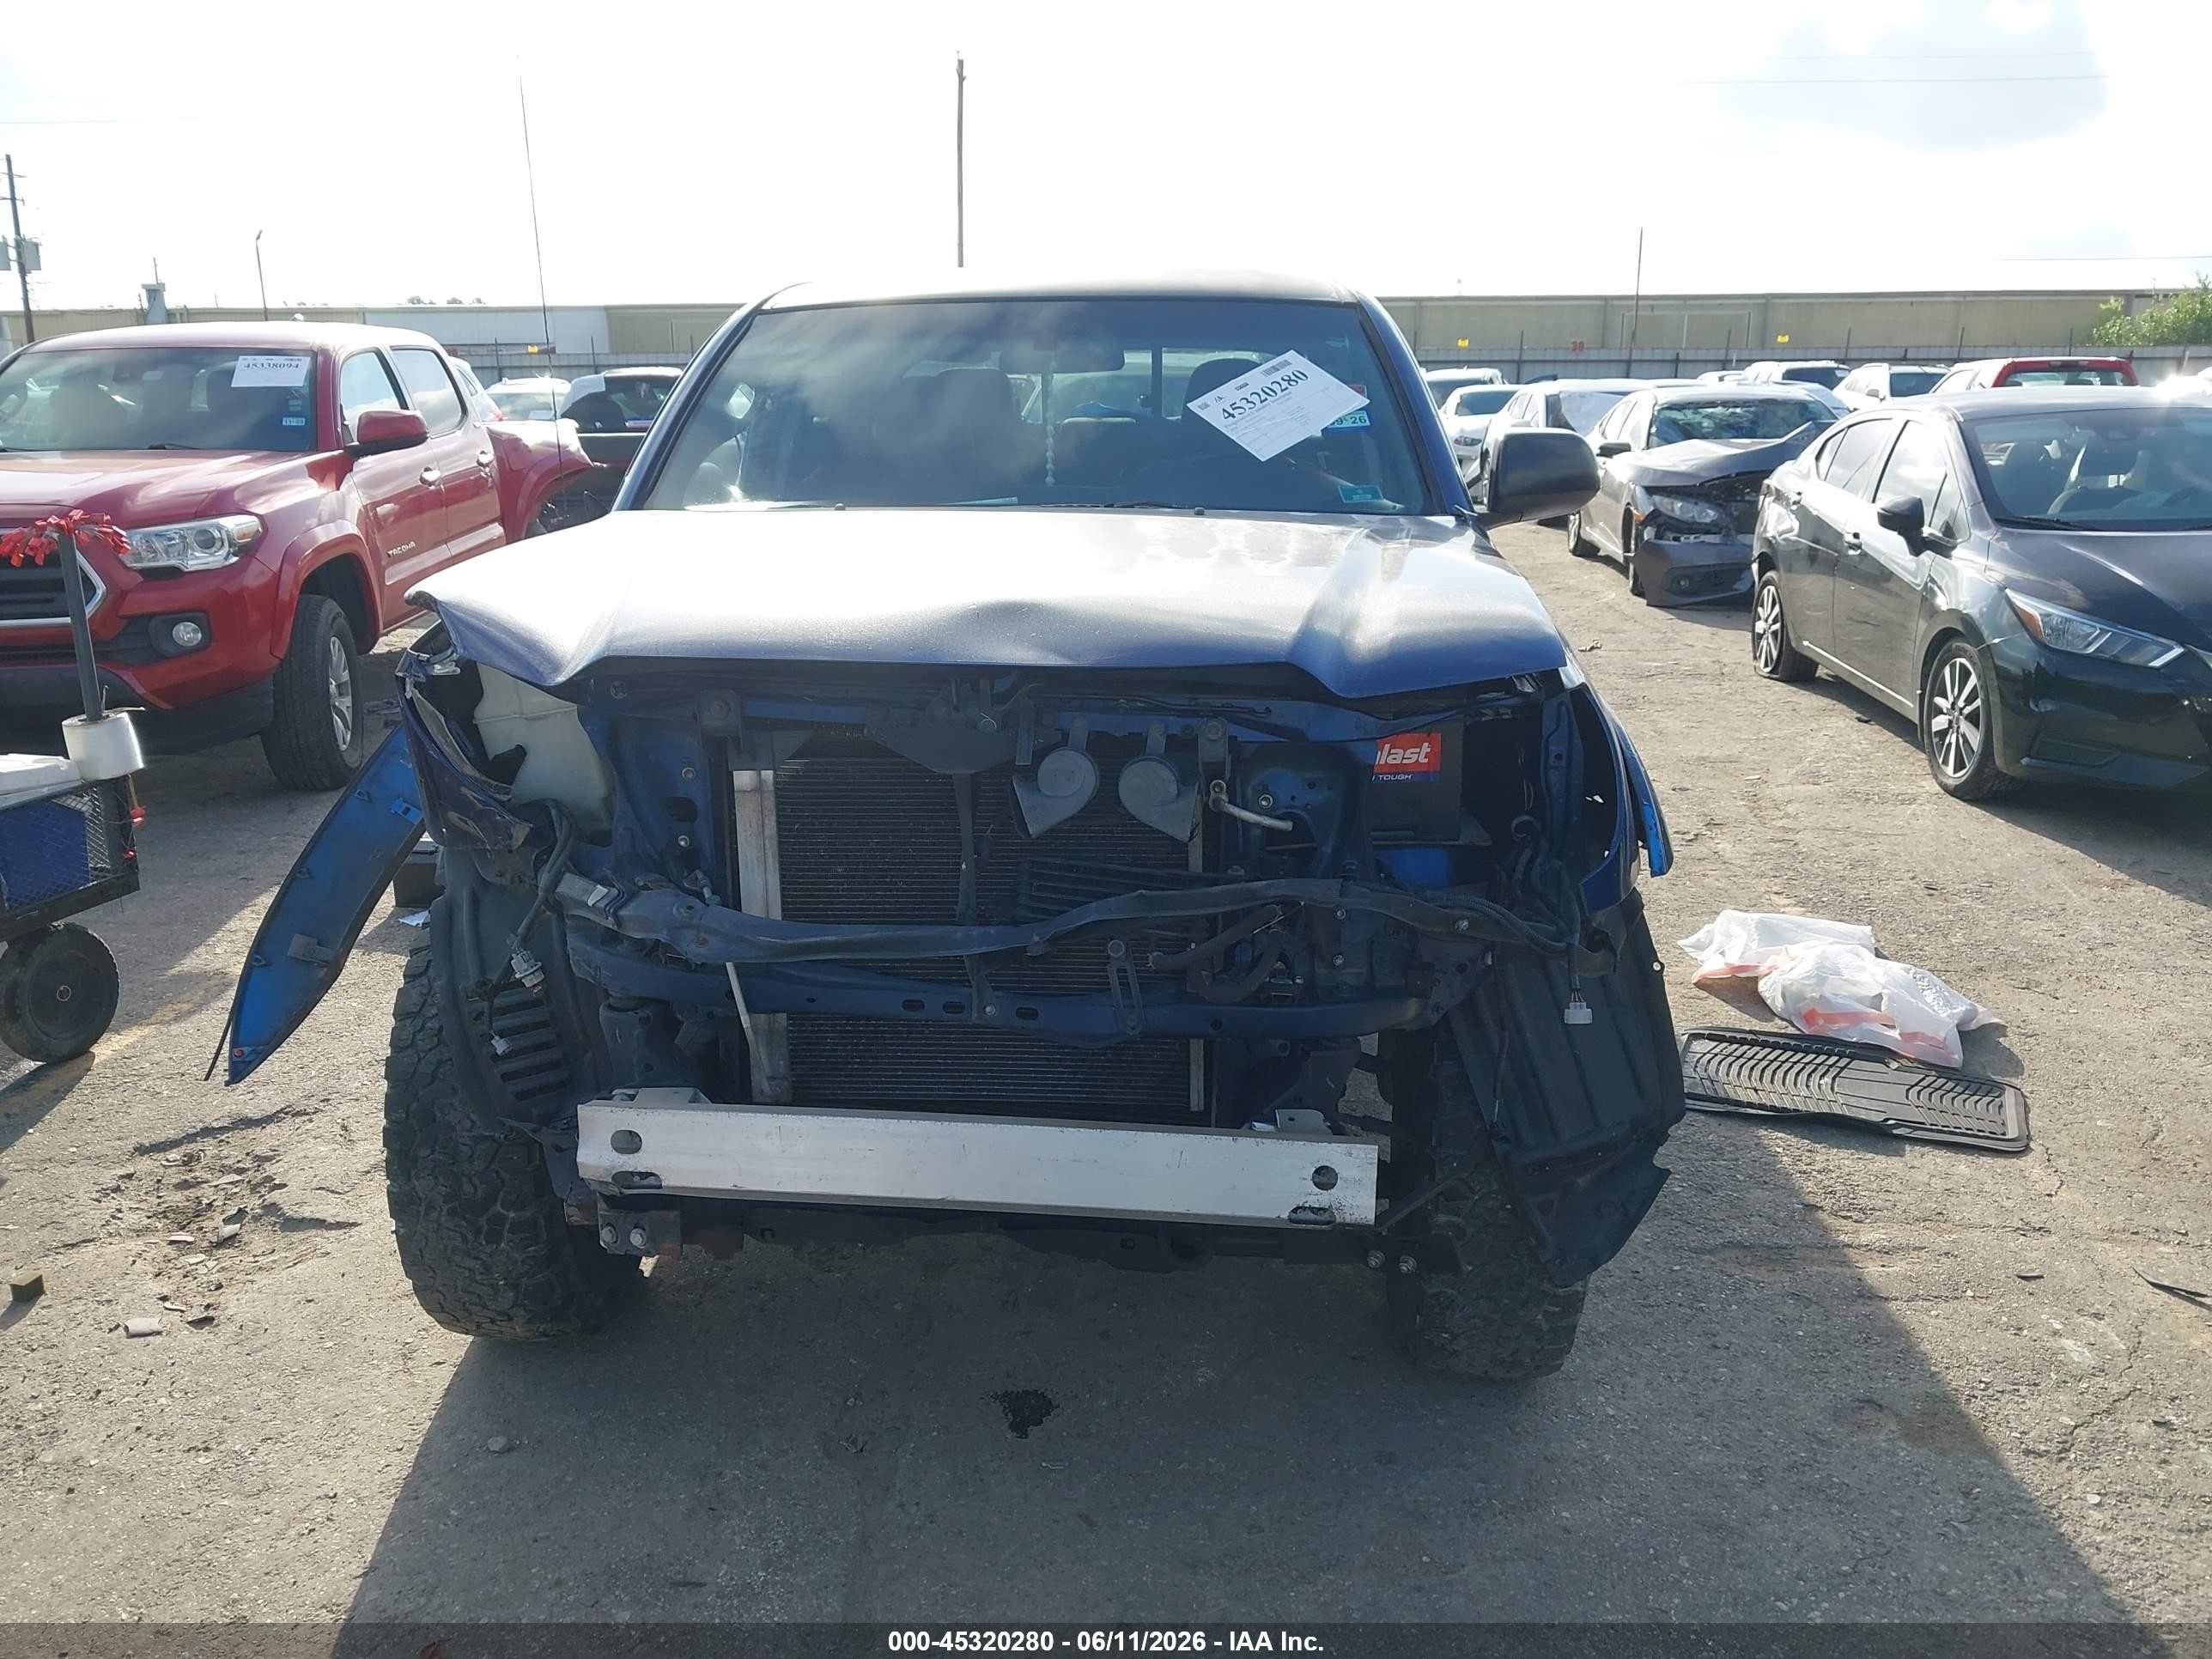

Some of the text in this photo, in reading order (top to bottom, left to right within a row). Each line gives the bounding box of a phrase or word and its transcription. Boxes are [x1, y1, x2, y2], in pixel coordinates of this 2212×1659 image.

[1222, 369, 1309, 420] 45320280
[1350, 416, 1367, 425] 26
[386, 540, 416, 558] TACOMA
